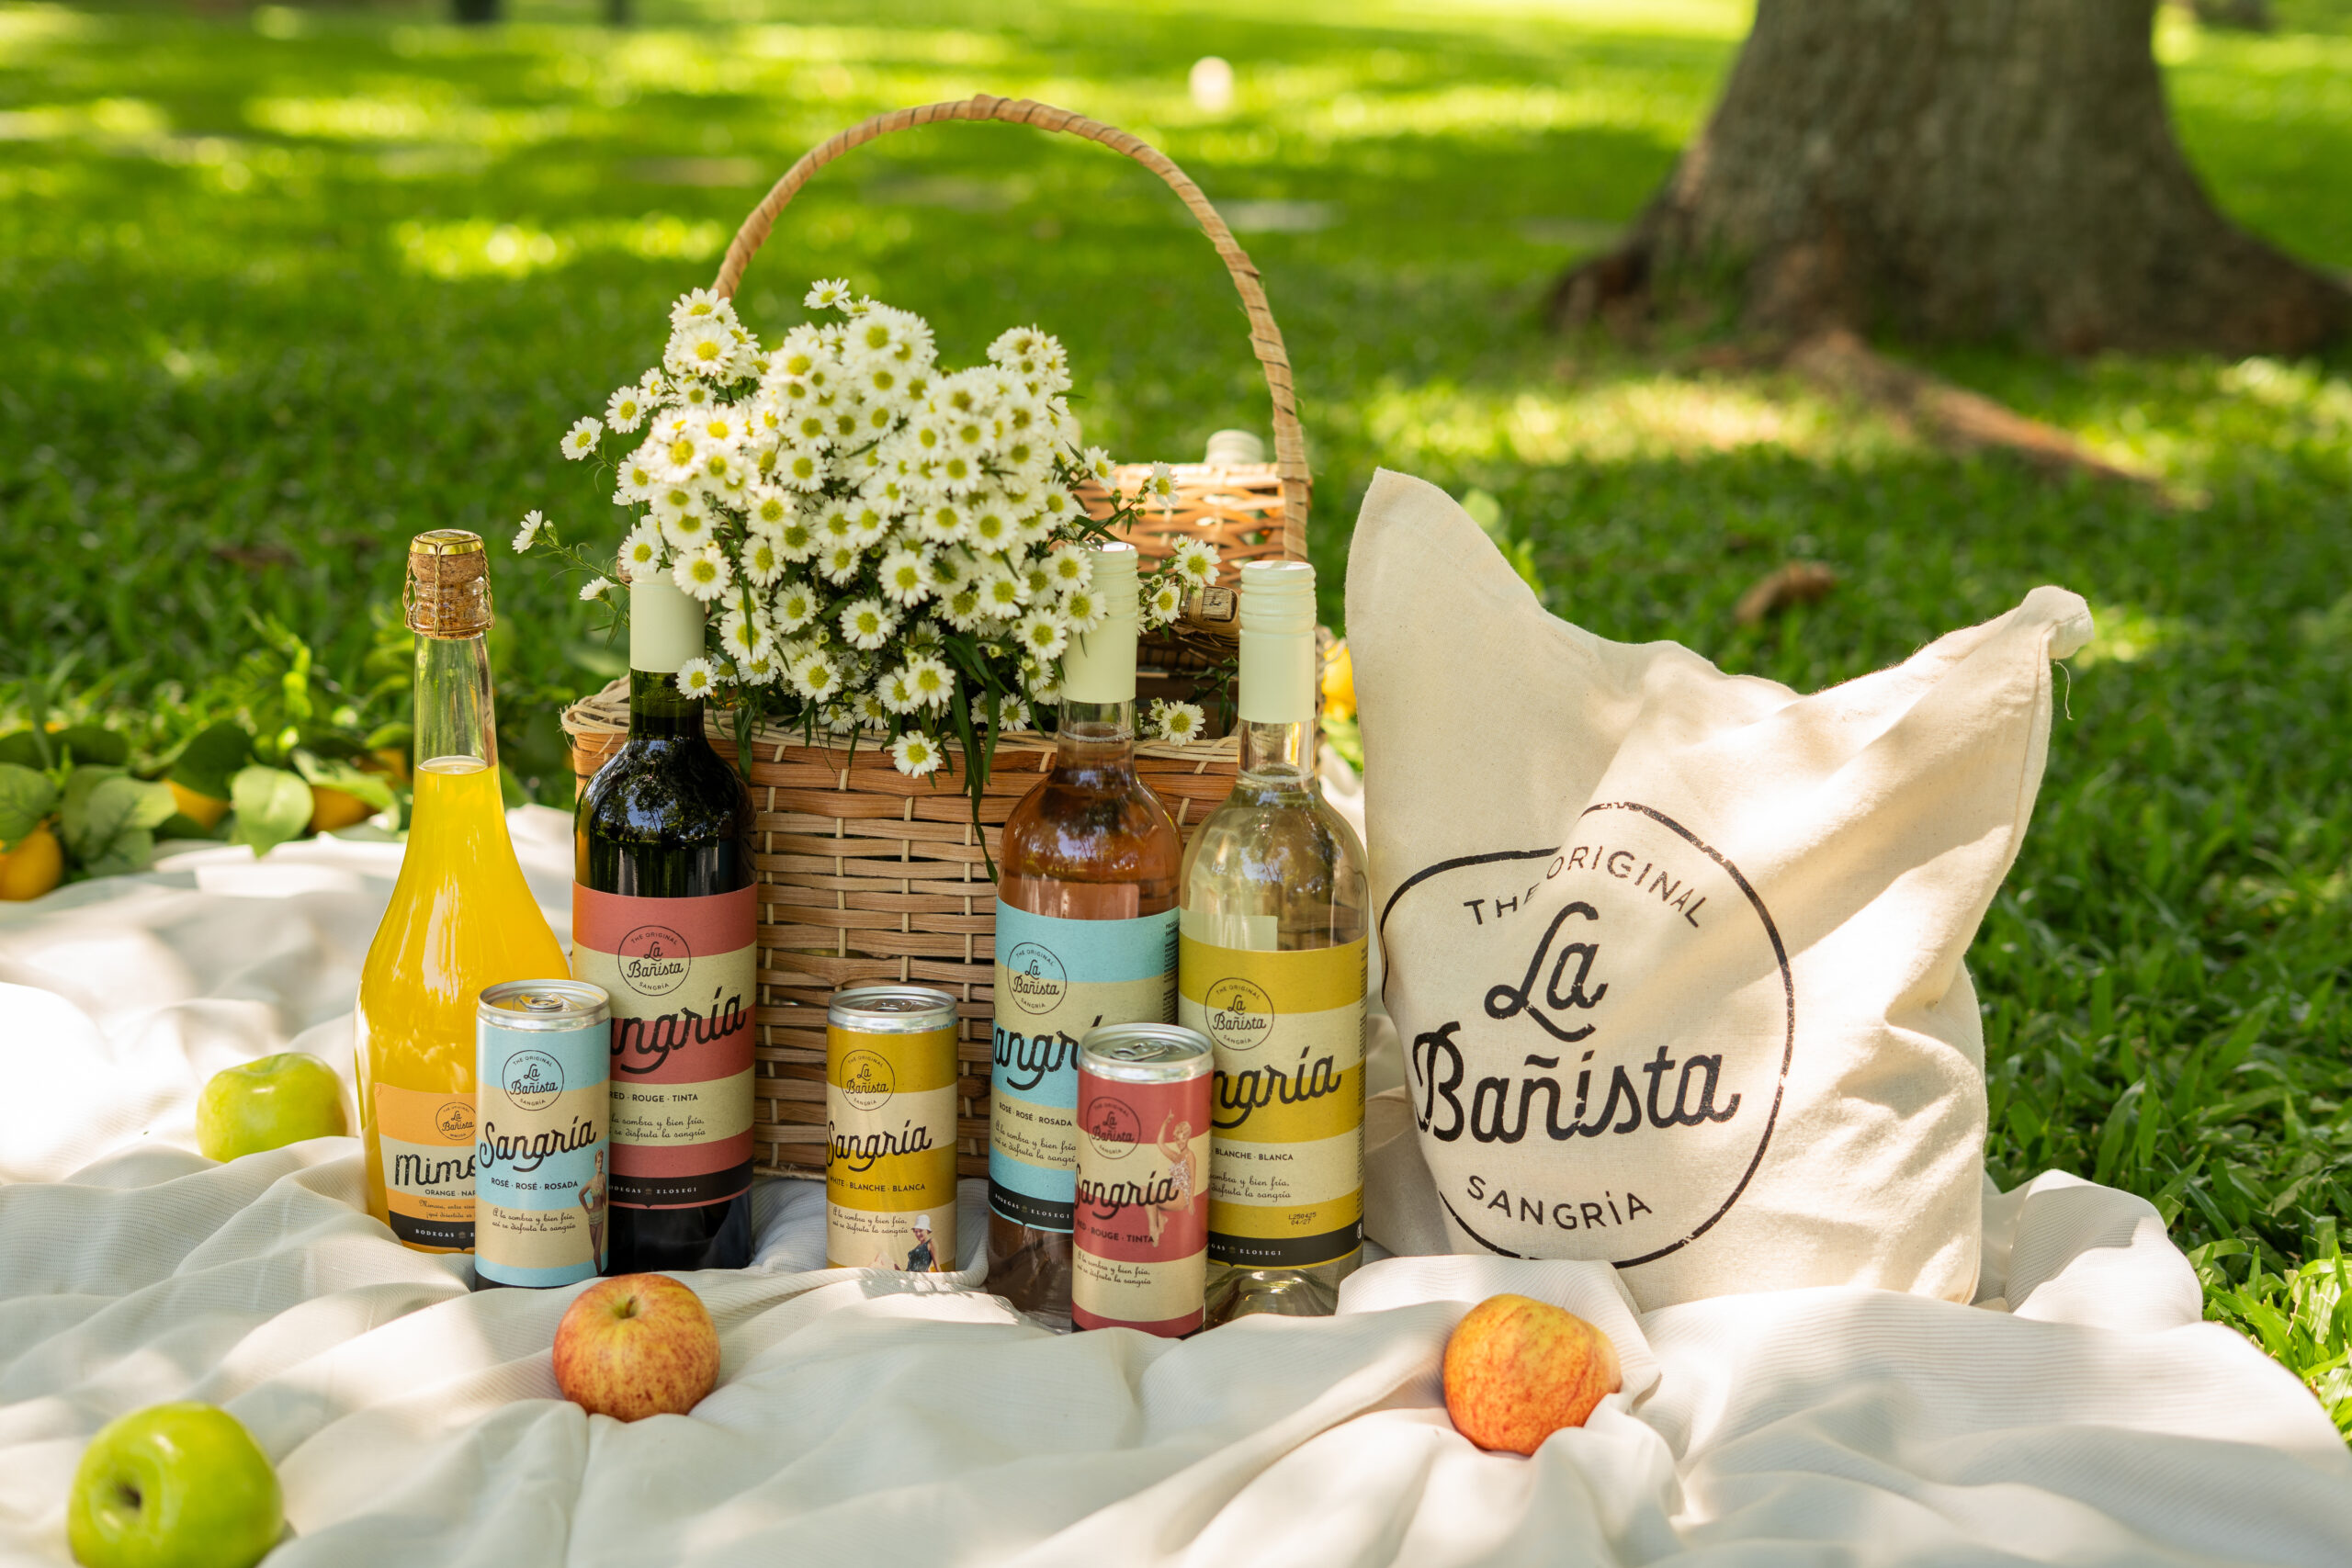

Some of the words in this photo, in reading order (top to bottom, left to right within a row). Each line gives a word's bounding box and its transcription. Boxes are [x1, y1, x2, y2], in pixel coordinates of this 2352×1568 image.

[1464, 883, 1540, 925] THE
[1546, 845, 1706, 928] ORIGINAL
[630, 934, 643, 943] THE
[645, 931, 678, 945] ORIGINAL
[643, 941, 663, 961] La
[1016, 950, 1025, 958] THE
[1027, 950, 1055, 966] ORIGINAL
[627, 959, 684, 977] Bañista
[1025, 959, 1040, 980] La
[1485, 902, 1608, 1043] La
[1012, 975, 1060, 995] Bañista
[1229, 985, 1261, 999] ORIGINAL
[1227, 994, 1246, 1015] La
[1213, 1011, 1266, 1030] Bañista
[610, 986, 746, 1074] ngría
[513, 1057, 524, 1066] THE
[526, 1056, 552, 1067] ORIGINAL
[524, 1064, 540, 1081] La
[856, 1064, 872, 1081] La
[509, 1079, 559, 1095] Bañista
[845, 1078, 889, 1094] Bañista
[1213, 1045, 1341, 1129] ngría
[1411, 1021, 1742, 1143] Bañista
[610, 1091, 625, 1100] RED
[632, 1094, 665, 1102] ROUGE
[673, 1094, 698, 1102] TINTA
[451, 1111, 462, 1122] La
[612, 1113, 619, 1122] la
[623, 1116, 652, 1126] sombra
[656, 1121, 662, 1130] y
[667, 1117, 684, 1126] bien
[1000, 1102, 1012, 1113] ROSÉ
[1016, 1110, 1033, 1121] ROSÉ
[1038, 1117, 1073, 1126] ROSADA
[1102, 1111, 1117, 1129] La
[441, 1121, 474, 1131] Bañista
[625, 1128, 658, 1141] disfruta
[662, 1128, 671, 1137] la
[674, 1128, 706, 1141] sangría
[1091, 1124, 1135, 1142] Bañista
[480, 1116, 596, 1172] Sangría
[827, 1119, 932, 1172] Sangría
[1007, 1132, 1029, 1144] sombra
[1033, 1141, 1037, 1150] y
[1040, 1138, 1057, 1149] bien
[1009, 1143, 1034, 1156] disfruta
[1036, 1150, 1044, 1159] la
[1047, 1156, 1076, 1167] sangrí
[1215, 1148, 1251, 1159] BLANCHE
[492, 1178, 509, 1187] ROSÉ
[516, 1182, 537, 1190] ROSÉ
[544, 1180, 579, 1190] ROSADA
[609, 1185, 641, 1193] ODEGAS
[831, 1176, 844, 1186] WHITE
[850, 1182, 886, 1191] BLANCHE
[893, 1183, 925, 1192] BLANCA
[1240, 1179, 1245, 1188] y
[1250, 1176, 1267, 1186] bien
[1211, 1183, 1242, 1197] disfruta
[1245, 1187, 1253, 1198] la
[1257, 1191, 1292, 1202] sangría
[508, 1213, 533, 1222] sombra
[544, 1213, 559, 1222] bien
[1031, 1209, 1069, 1219] ELOSEGI
[415, 1229, 454, 1237] BODEGAS
[511, 1222, 537, 1234] disfruta
[549, 1223, 576, 1233] sangría
[1091, 1227, 1119, 1240] ROUGE
